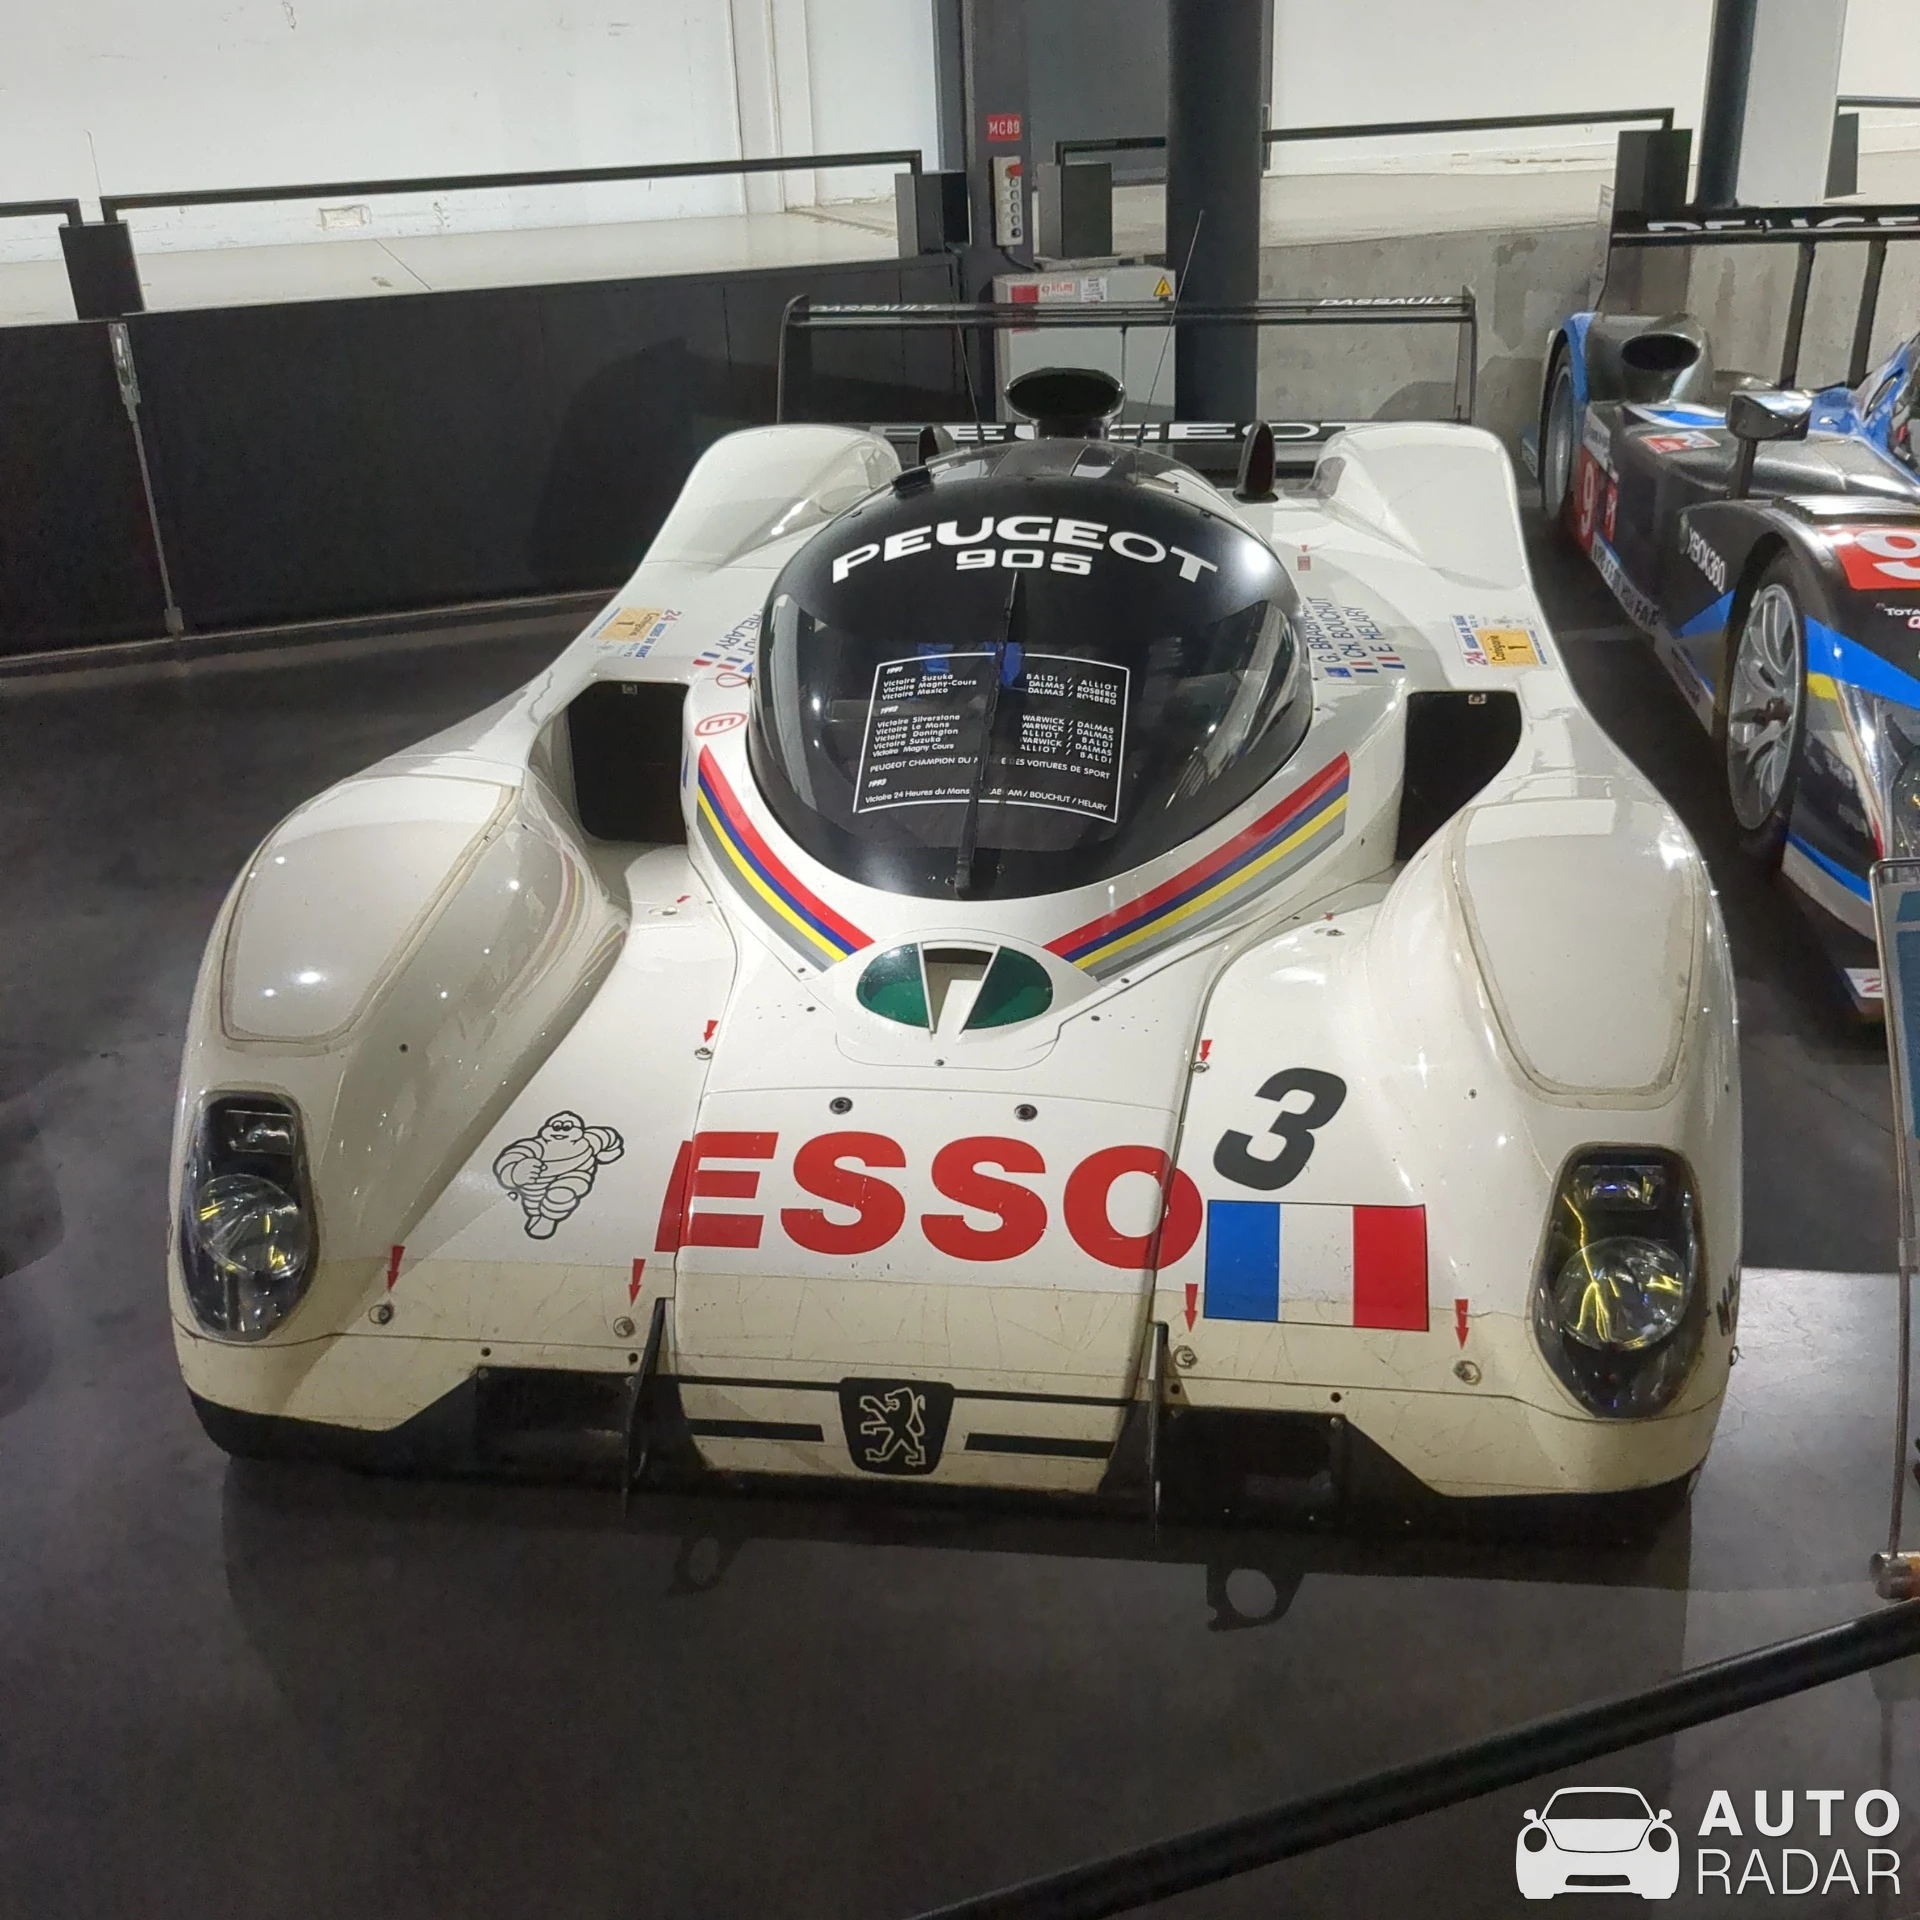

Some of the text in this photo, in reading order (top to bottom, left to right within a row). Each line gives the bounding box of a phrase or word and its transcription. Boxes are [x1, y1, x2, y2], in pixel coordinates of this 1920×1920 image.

[811, 304, 937, 312] DASSAULT
[1319, 296, 1454, 306] DASSAULT
[833, 515, 1218, 583] PEUGEOT
[1854, 528, 1920, 581] 9
[956, 549, 1093, 575] 905
[661, 609, 682, 621] 24
[1306, 596, 1354, 639] BOUCHUT
[1341, 606, 1386, 640] HELARY
[1463, 651, 1489, 665] 24
[883, 674, 953, 687] Victoire Suzuka
[883, 679, 977, 693] Victoire Magny-Cours
[1026, 673, 1058, 682] BALDI
[1081, 679, 1118, 691] ALLIOT
[1029, 680, 1065, 690] DALMAS
[882, 687, 948, 700] Victoire Mexico
[1028, 687, 1064, 697] DALMAS
[877, 714, 960, 728] Victoire Silverstone
[1022, 714, 1065, 725] WARWICK
[1077, 721, 1114, 734] DALMAS
[875, 729, 958, 743] Victoire Donington
[876, 726, 908, 736] Victoire
[1021, 722, 1064, 732] WARWICK
[1076, 728, 1113, 741] DALMAS
[873, 737, 941, 750] Victoire Suzuka
[1022, 729, 1059, 739] ALLIOT
[1081, 737, 1113, 749] BALDI
[872, 743, 954, 758] Victoire Magny Cours
[1020, 744, 1057, 754] ALLIOT
[1080, 751, 1112, 764] BALDI
[1075, 743, 1112, 756] DALMAS
[870, 760, 907, 773] PEUGEOT
[908, 757, 955, 767] CHAMPION
[1026, 759, 1068, 771] VOITURES
[1070, 765, 1081, 774] DE
[1083, 767, 1111, 779] SPORT
[865, 794, 892, 804] Victoire
[893, 791, 904, 799] 24
[905, 789, 933, 798] Heures
[1029, 791, 1071, 803] BOUCHUT
[1077, 799, 1108, 811] HELARY
[1213, 1067, 1347, 1190] 3
[654, 1130, 1203, 1270] ESSO
